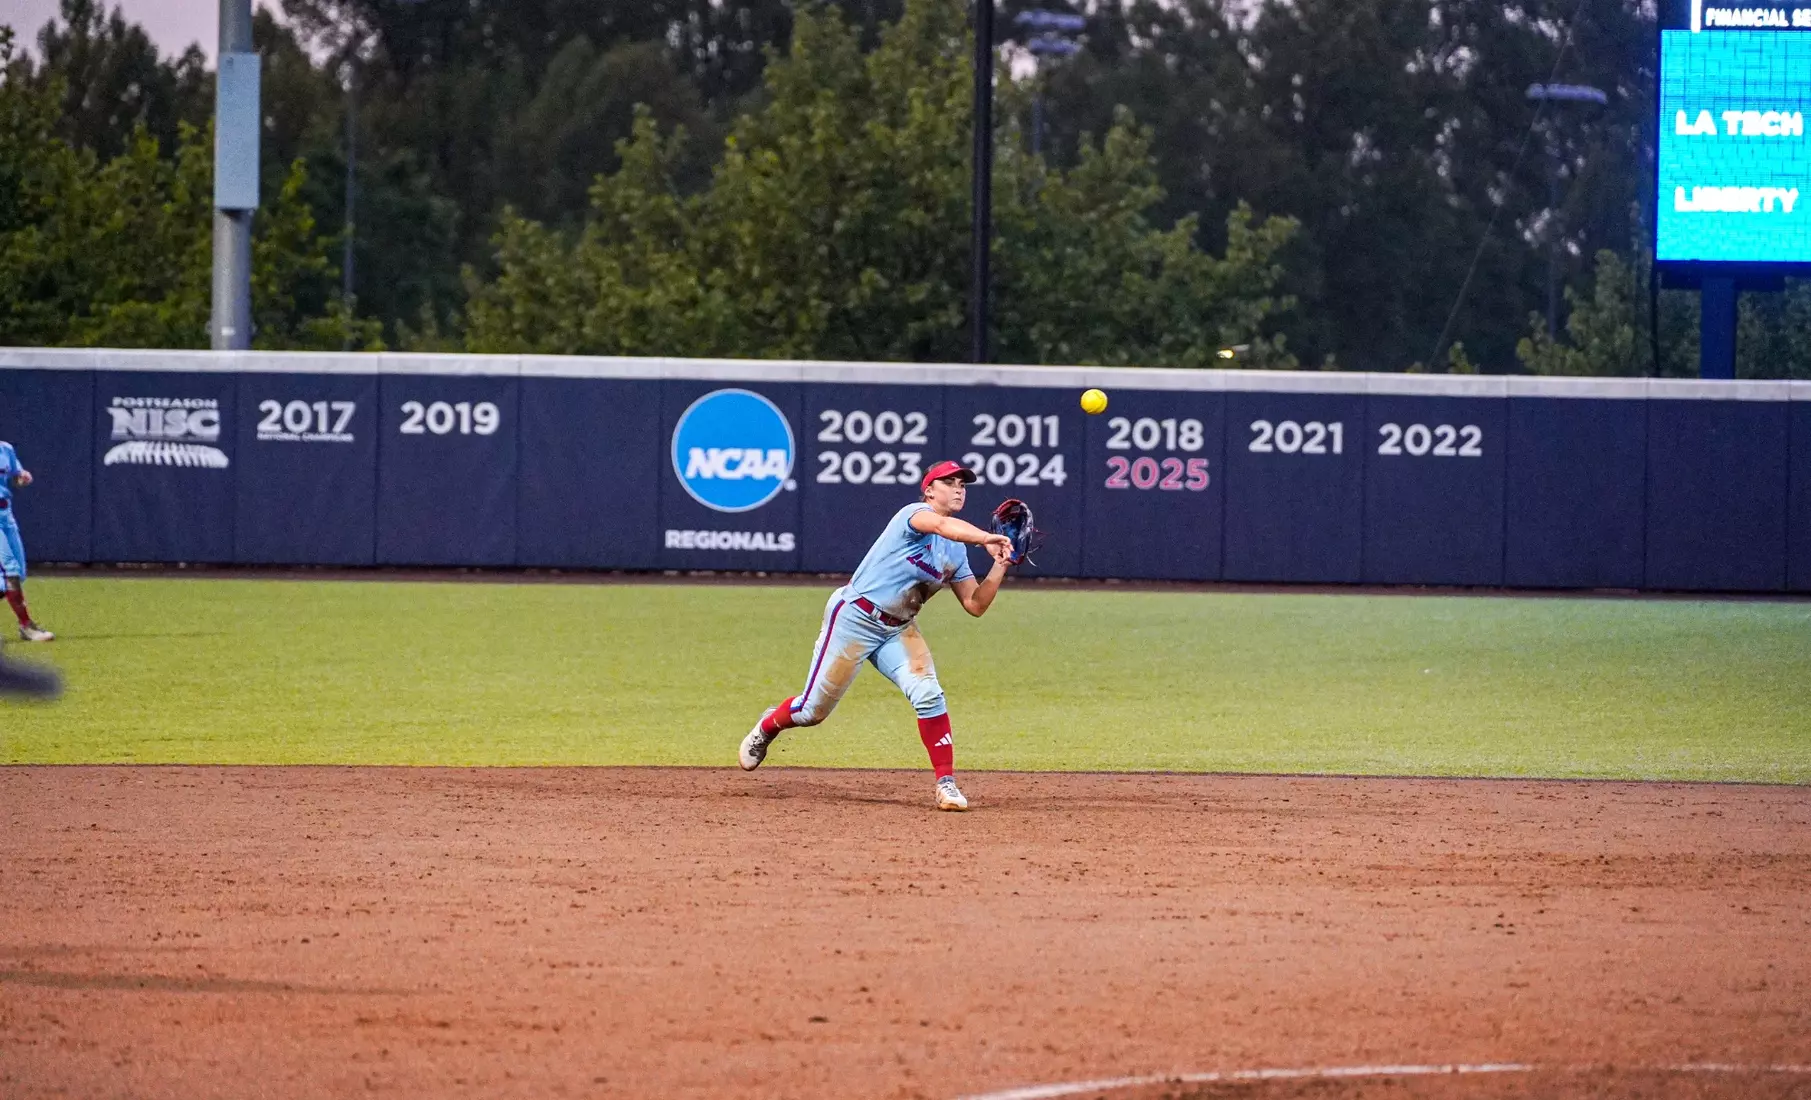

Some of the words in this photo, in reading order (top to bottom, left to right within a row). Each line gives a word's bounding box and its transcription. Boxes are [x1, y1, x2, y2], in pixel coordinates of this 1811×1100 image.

[1705, 8, 1789, 27] FINANCIAL
[1675, 109, 1717, 136] LA
[1722, 110, 1804, 136] TECH
[1674, 186, 1799, 213] LIBERTY
[112, 397, 218, 409] POSTSEASON
[257, 399, 355, 433] 2017
[400, 401, 500, 435] 2019
[106, 407, 220, 441] NISC
[817, 410, 927, 444] 2002
[971, 413, 1060, 448] 2011
[1106, 417, 1204, 451] 2018
[1248, 419, 1344, 455] 2021
[1378, 423, 1482, 457] 2022
[685, 447, 788, 480] NCAA
[816, 451, 922, 485] 2023
[962, 452, 1067, 487] 2024
[1105, 456, 1210, 491] 2025
[665, 530, 796, 552] REGIONALS
